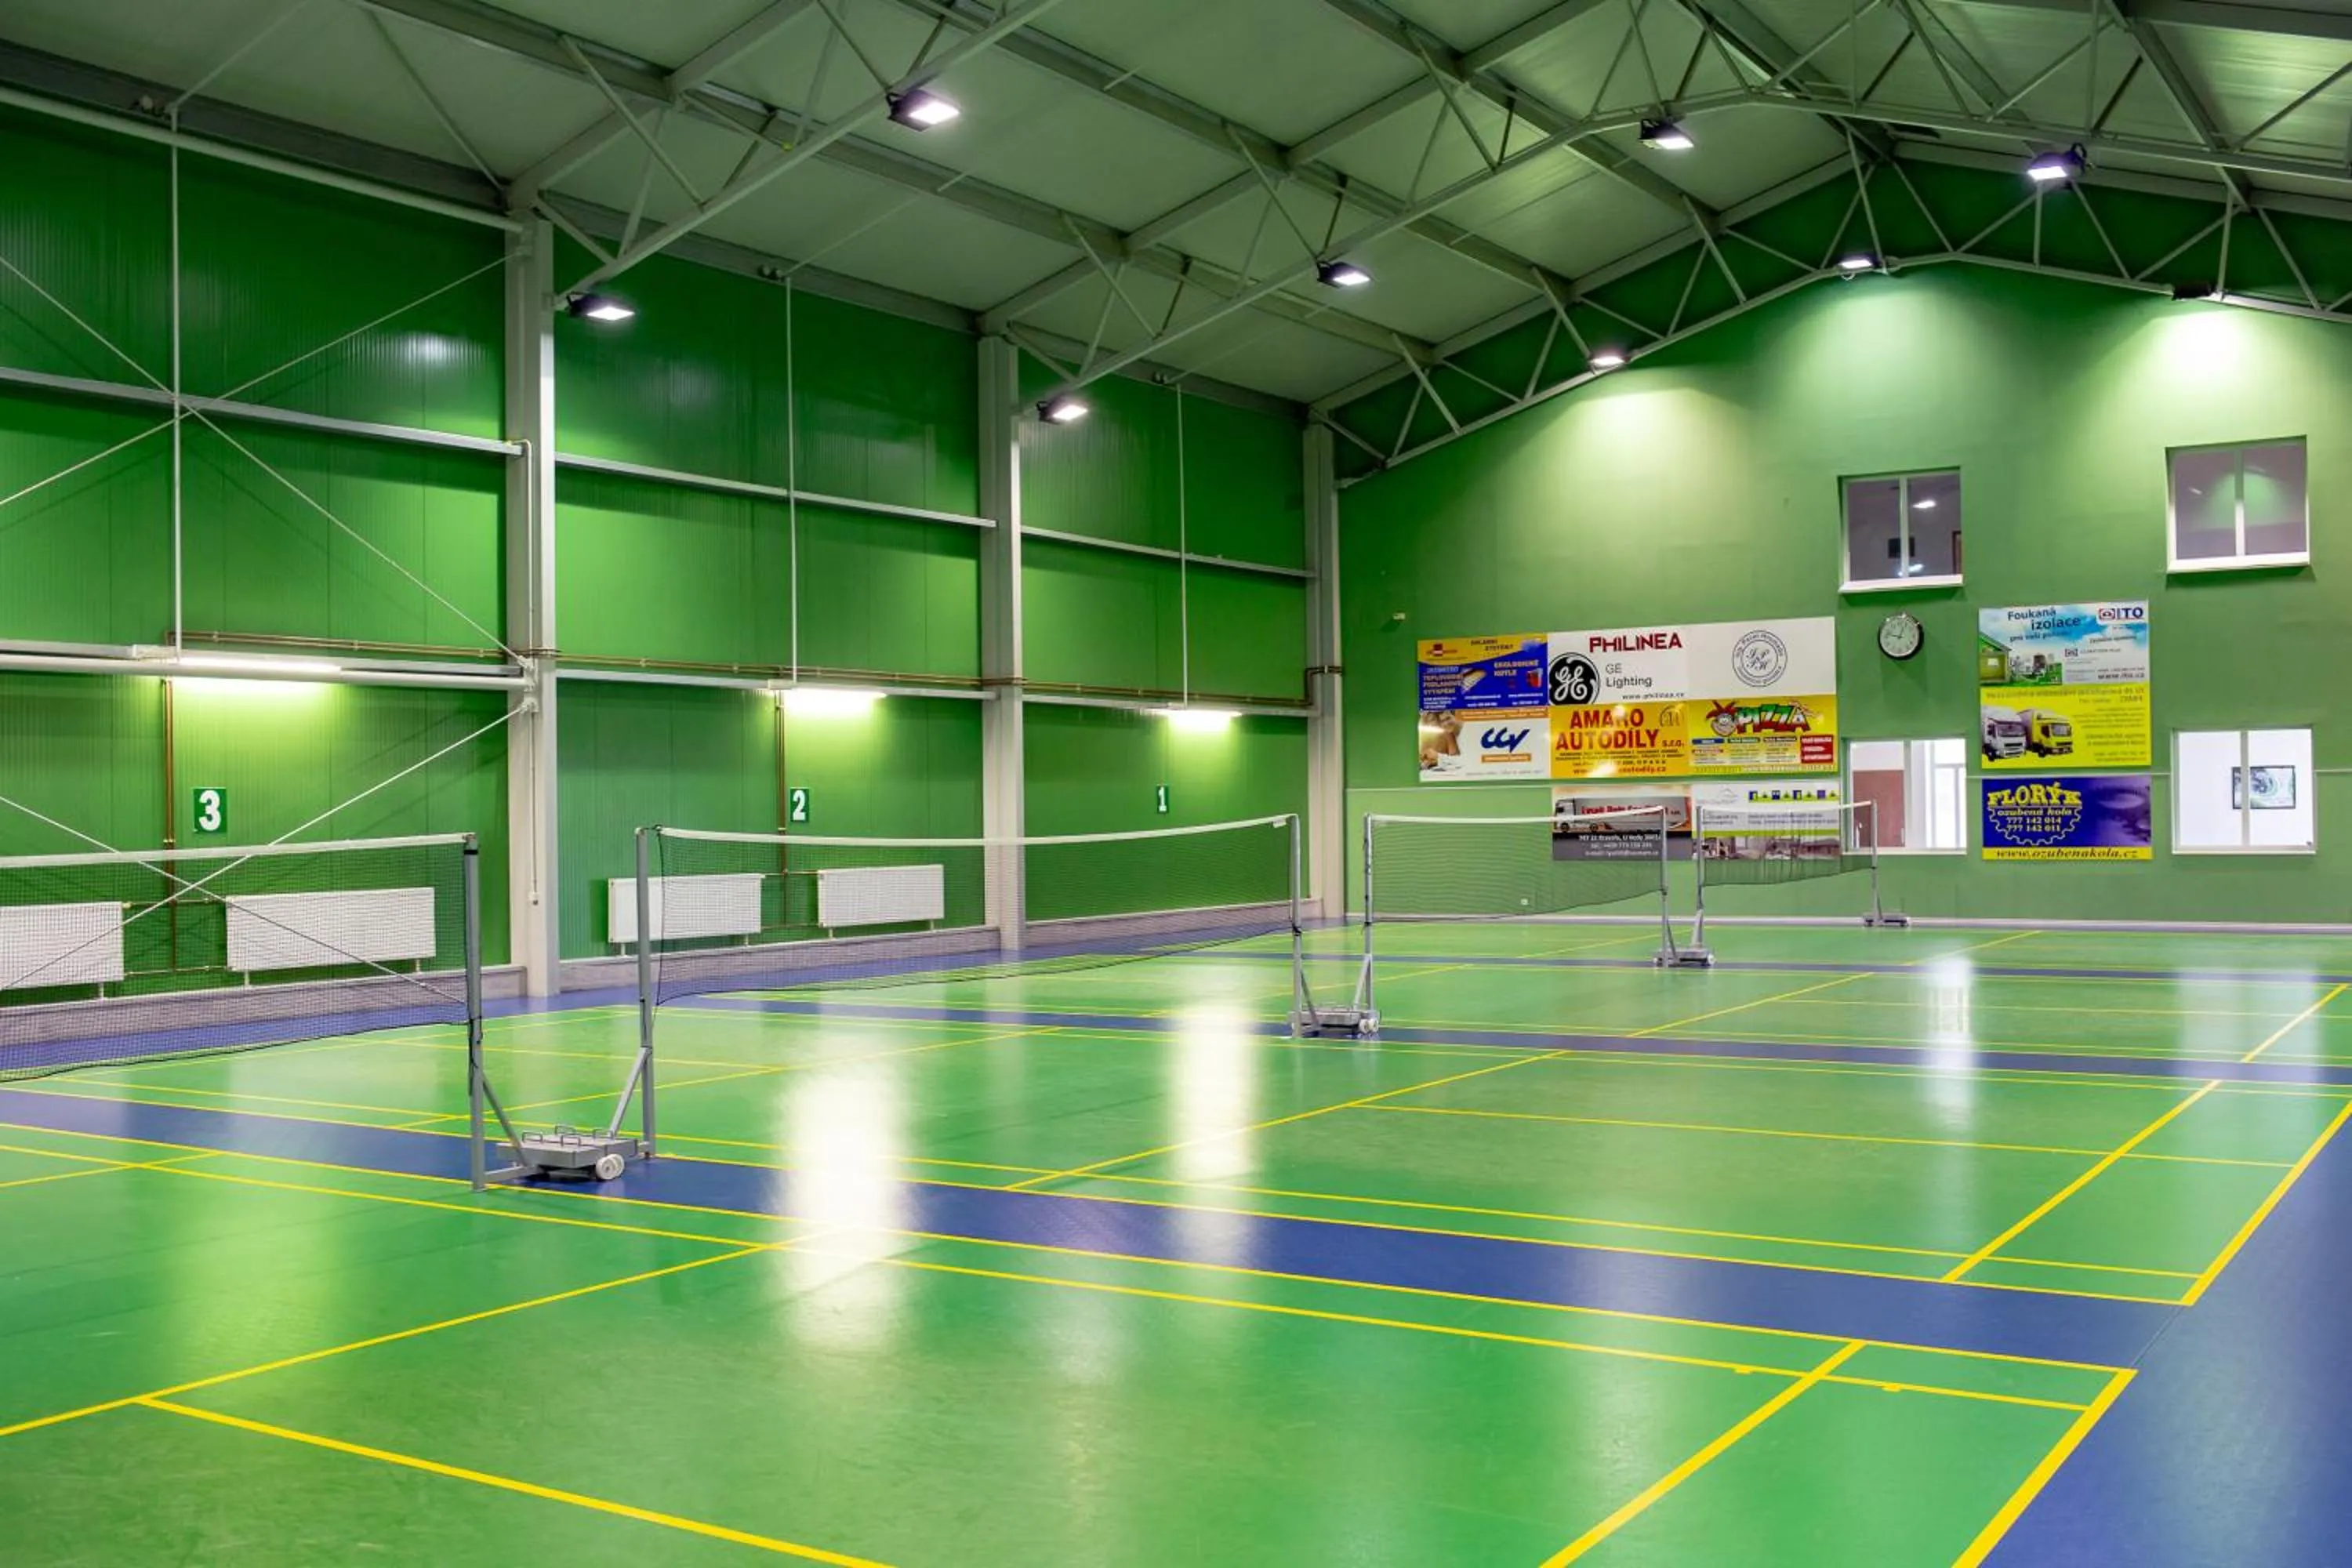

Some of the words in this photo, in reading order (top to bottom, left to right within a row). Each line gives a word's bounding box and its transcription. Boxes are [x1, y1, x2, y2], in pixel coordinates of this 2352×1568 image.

[2007, 607, 2056, 621] Foukaná
[2031, 618, 2081, 630] izolace
[1589, 632, 1682, 652] PHILINEA
[1606, 663, 1622, 673] GE
[1606, 676, 1653, 688] Lighting
[1737, 704, 1811, 734] PIZZA
[1555, 728, 1659, 750] AUTODÍLY
[1158, 786, 1167, 811] 1
[1987, 782, 2082, 807] FLORÝK
[198, 789, 222, 831] 3
[793, 789, 806, 821] 2
[2047, 808, 2072, 816] kola
[1997, 848, 2138, 858] www.ozubenakola.cz
